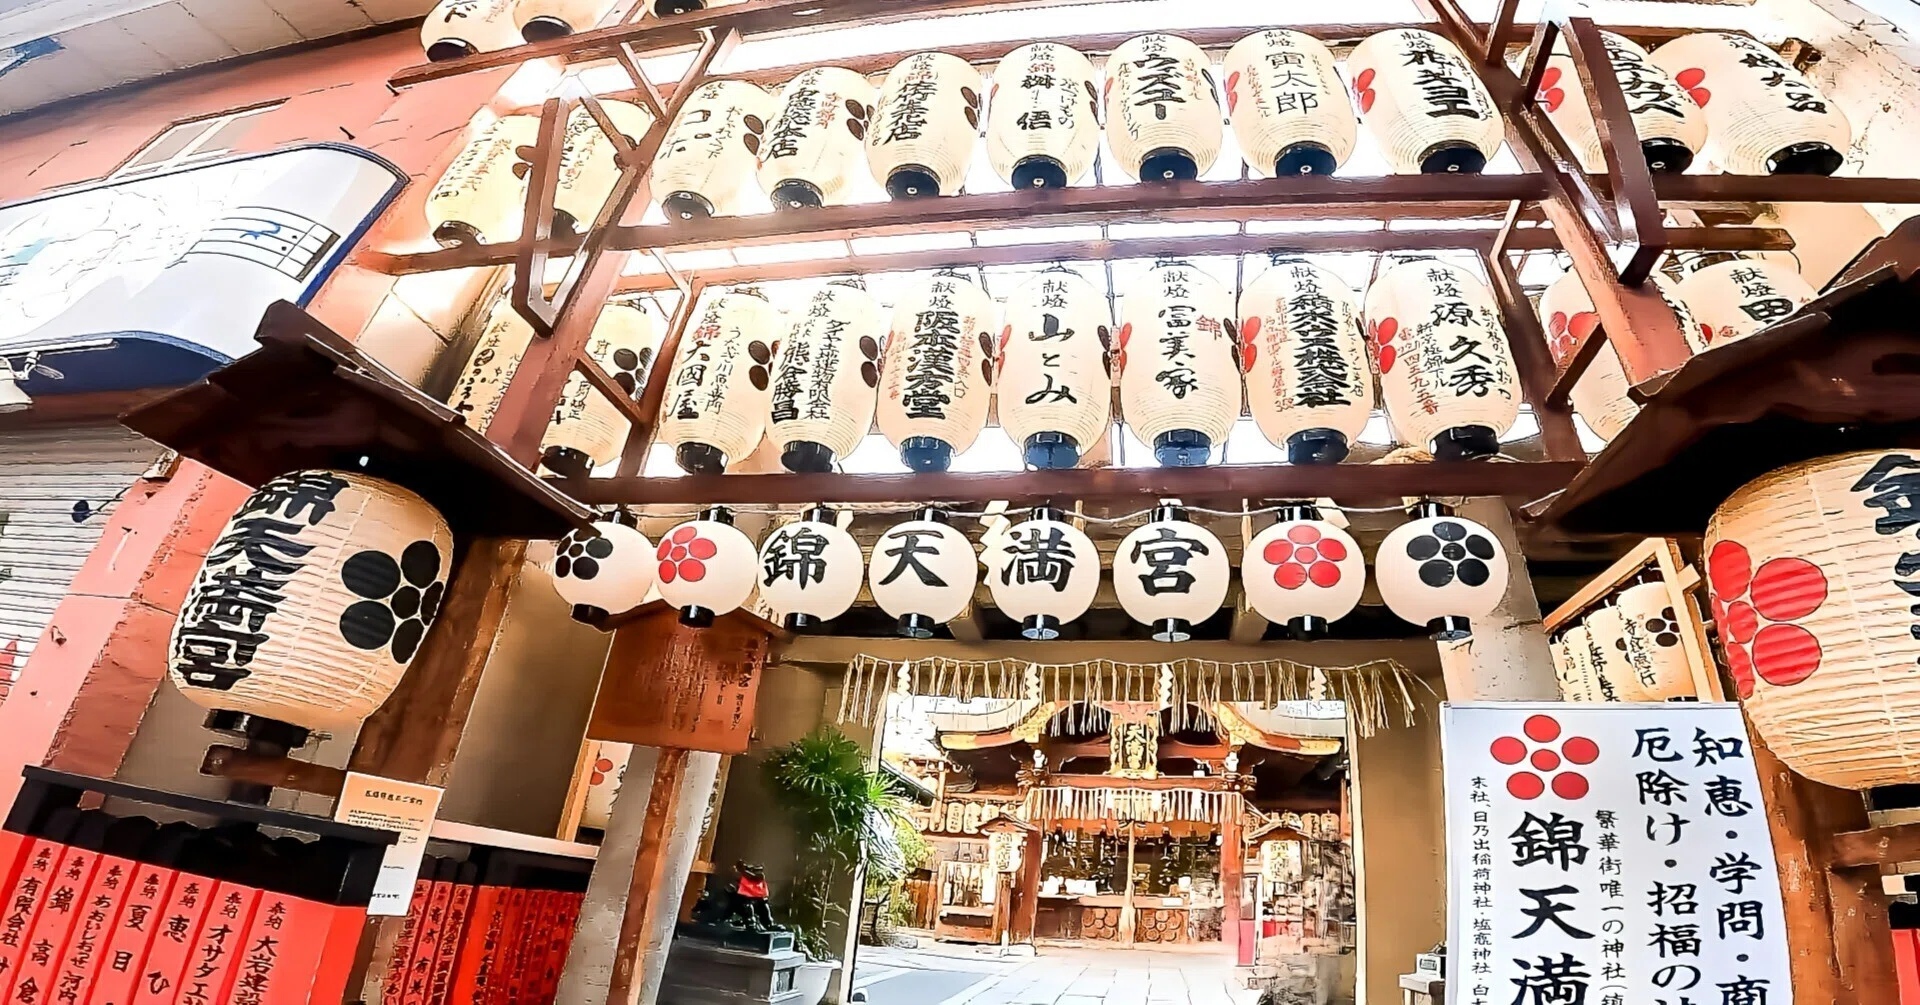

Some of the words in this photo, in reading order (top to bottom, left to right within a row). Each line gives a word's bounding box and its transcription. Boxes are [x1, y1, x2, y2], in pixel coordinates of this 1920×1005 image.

[1265, 51, 1319, 115] 寅太郎
[902, 310, 961, 420] 阪本漢方堂
[1025, 312, 1078, 405] 山とみ
[763, 528, 830, 591] 錦
[878, 530, 950, 588] 天
[1000, 527, 1077, 593] 満
[1130, 527, 1210, 597] 宮
[1631, 727, 1703, 1005] 厄除け・招福の
